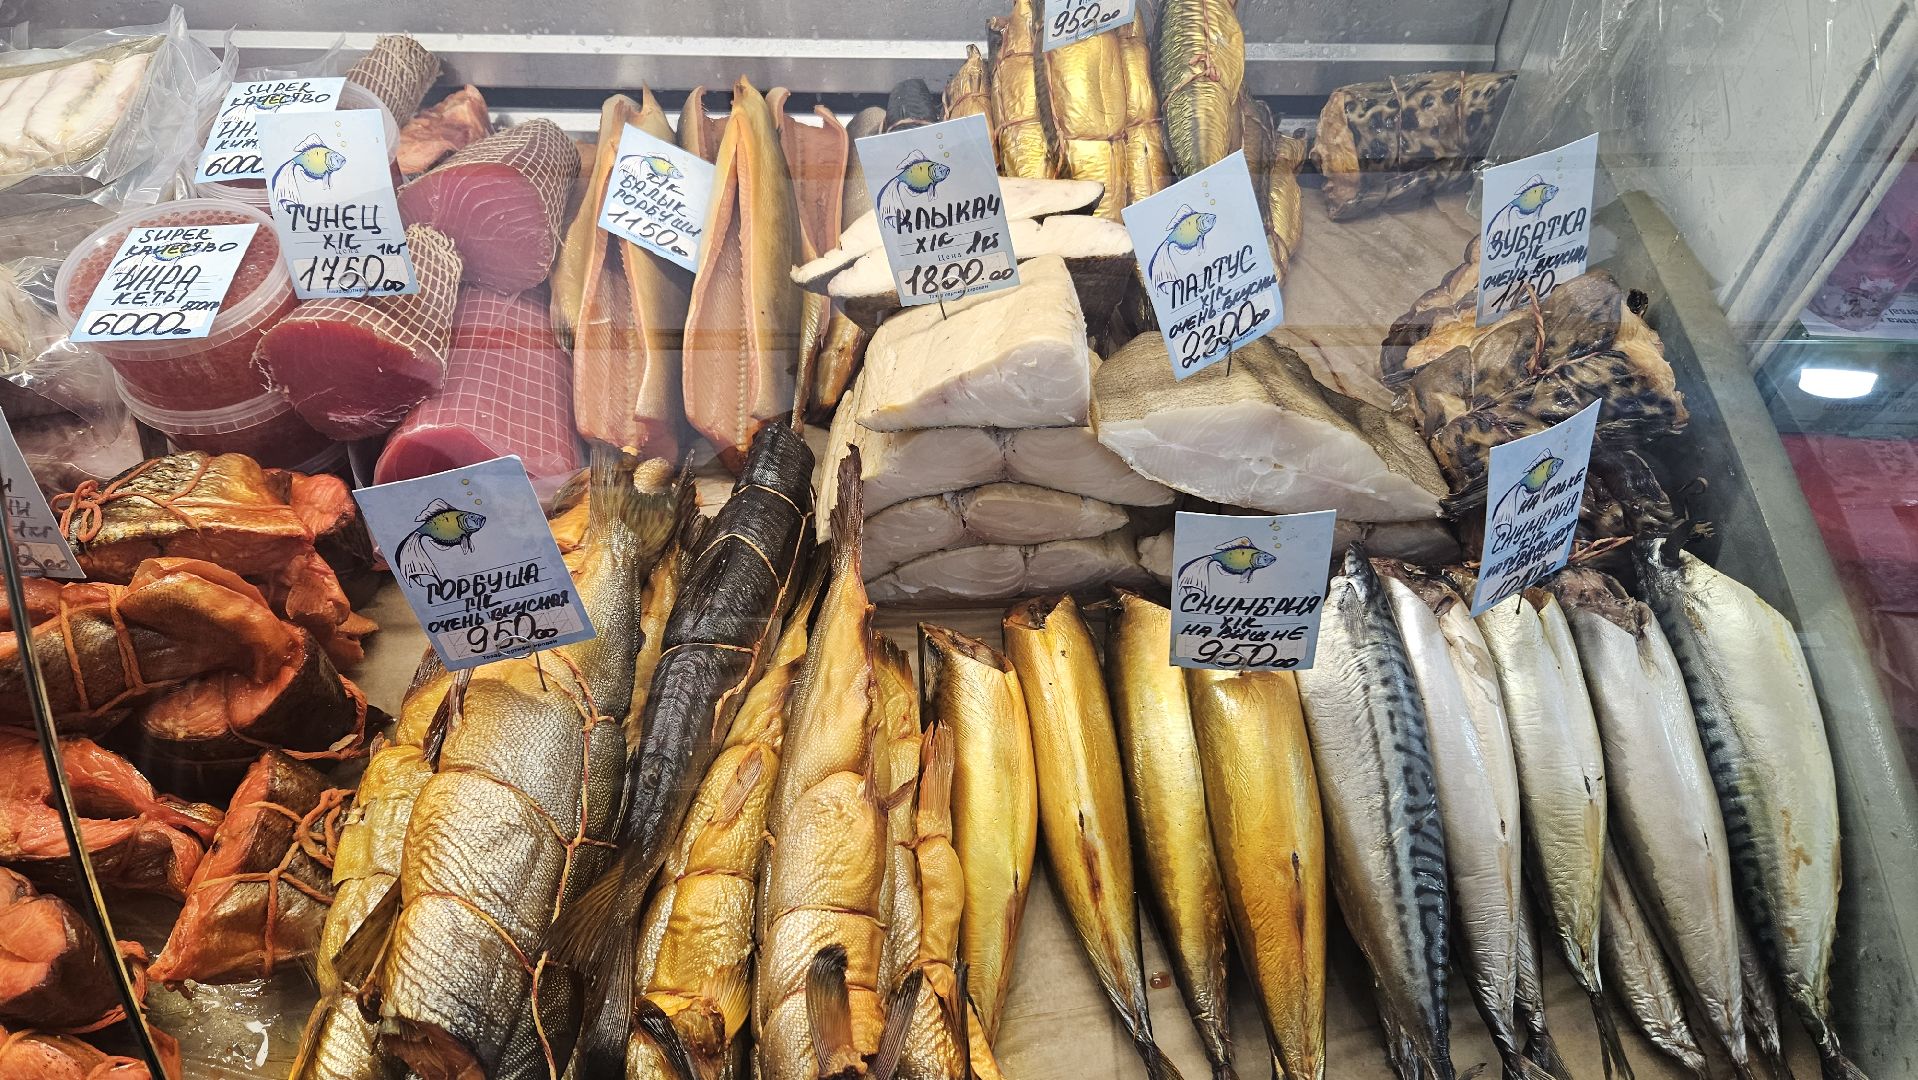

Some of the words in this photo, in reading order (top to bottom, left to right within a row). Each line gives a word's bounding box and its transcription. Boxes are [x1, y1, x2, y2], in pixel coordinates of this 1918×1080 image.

[244, 82, 316, 96] SUPER
[620, 174, 686, 217] БАЛЫК
[286, 203, 382, 234] ТУНЕЦ
[613, 188, 702, 237] ГОРБУШИ
[896, 193, 1001, 235] КЛЫКАЧ
[138, 228, 213, 243] SUPER
[1488, 207, 1586, 260] ЗУБАТКА
[1171, 244, 1256, 309] ПАЛТУС
[1483, 265, 1528, 291] ОЧЕНЬ
[111, 290, 188, 306] КЕТЫ
[1169, 307, 1217, 339] ОЧЕНЬ
[1517, 493, 1541, 515] НА
[1492, 491, 1580, 555] СКУМБРИЯ
[427, 562, 539, 604] ГОРБУША
[1180, 592, 1322, 617] СКУМБРИЯ
[428, 613, 485, 634] ОЧЕНЬ
[1181, 623, 1212, 638] НА
